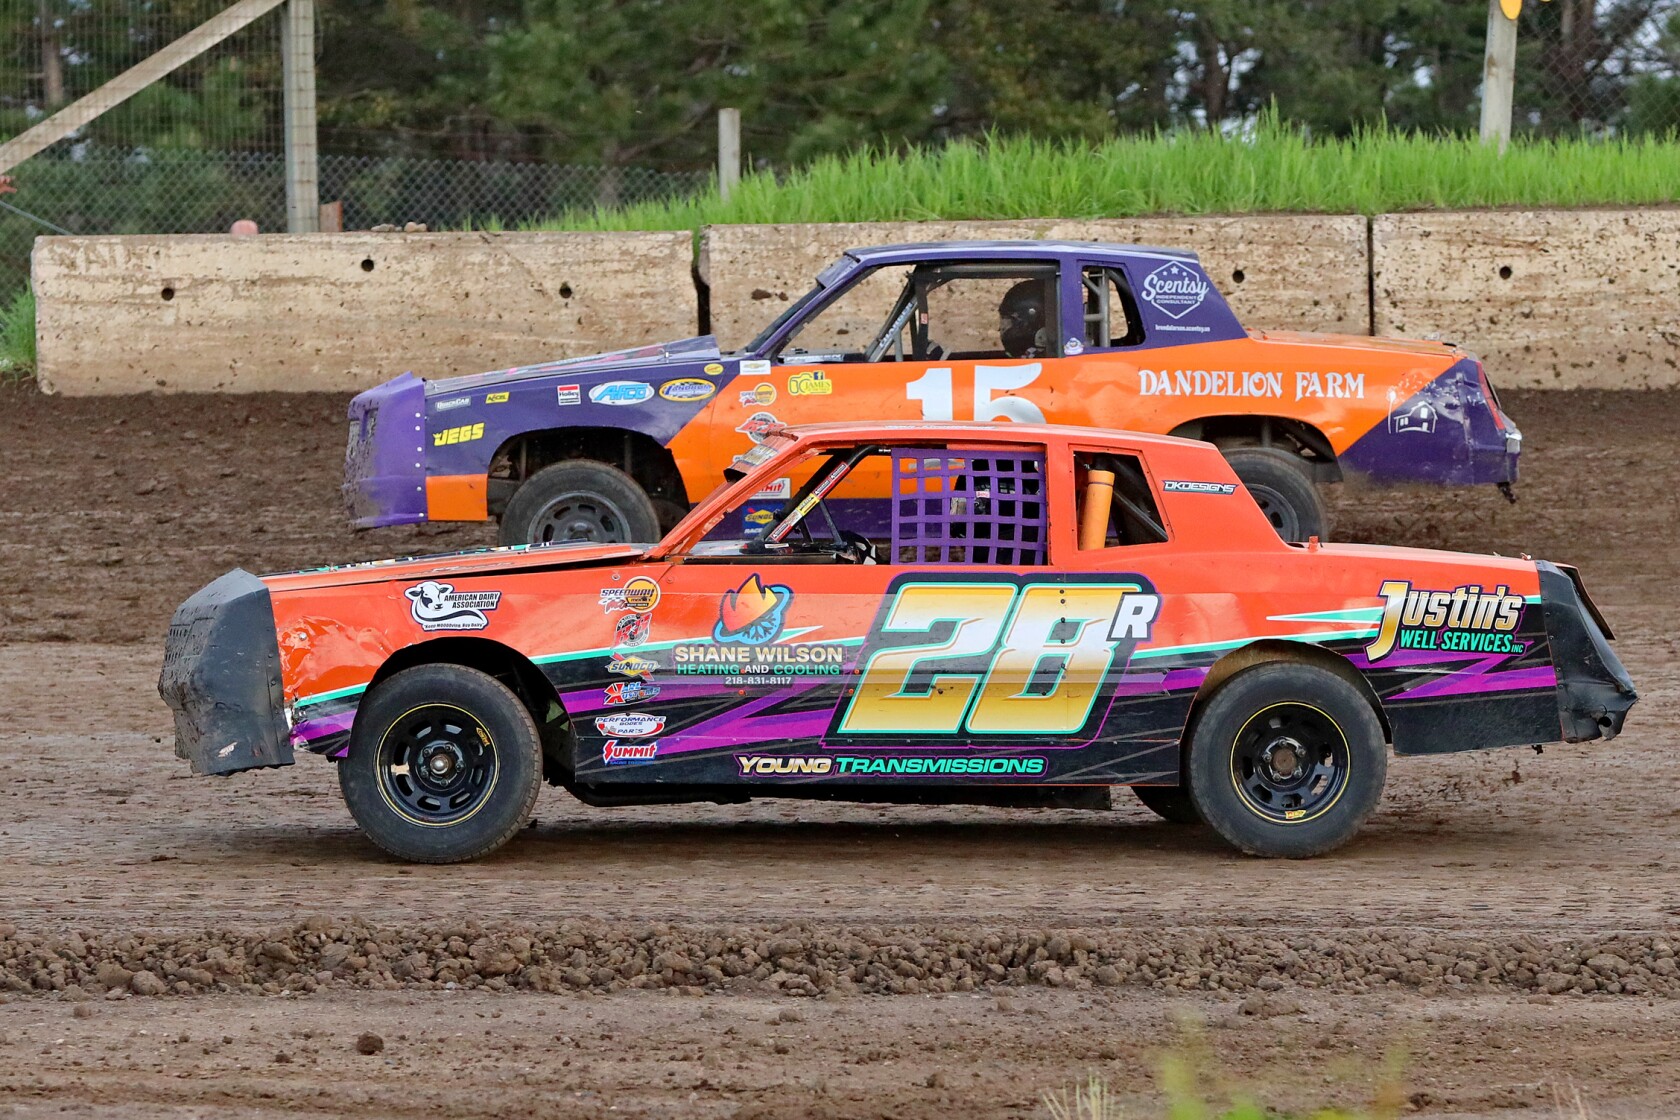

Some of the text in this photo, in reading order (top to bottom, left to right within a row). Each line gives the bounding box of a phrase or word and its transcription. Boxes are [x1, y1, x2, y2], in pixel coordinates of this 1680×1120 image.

[1141, 274, 1209, 302] Scentsy
[906, 361, 1046, 422] 15
[1138, 369, 1365, 402] DANDELION FARM
[559, 390, 580, 398] Holley
[433, 422, 485, 446] JEGS
[444, 593, 499, 603] AMERICAN DAIRY
[602, 588, 655, 597] SPEEDWAY
[452, 601, 496, 609] ASSOCIATION
[1365, 581, 1524, 662] Justin's
[1400, 629, 1524, 654] WELL SERVICES INC
[674, 646, 843, 662] SHANE WILSON
[837, 581, 1143, 735] 28
[611, 663, 654, 671] SUNOCO
[677, 664, 840, 675] HEATING AND COOLING
[725, 676, 792, 685] 218-831-8117
[738, 756, 1044, 773] YOUNG TRANSMISSIONS
